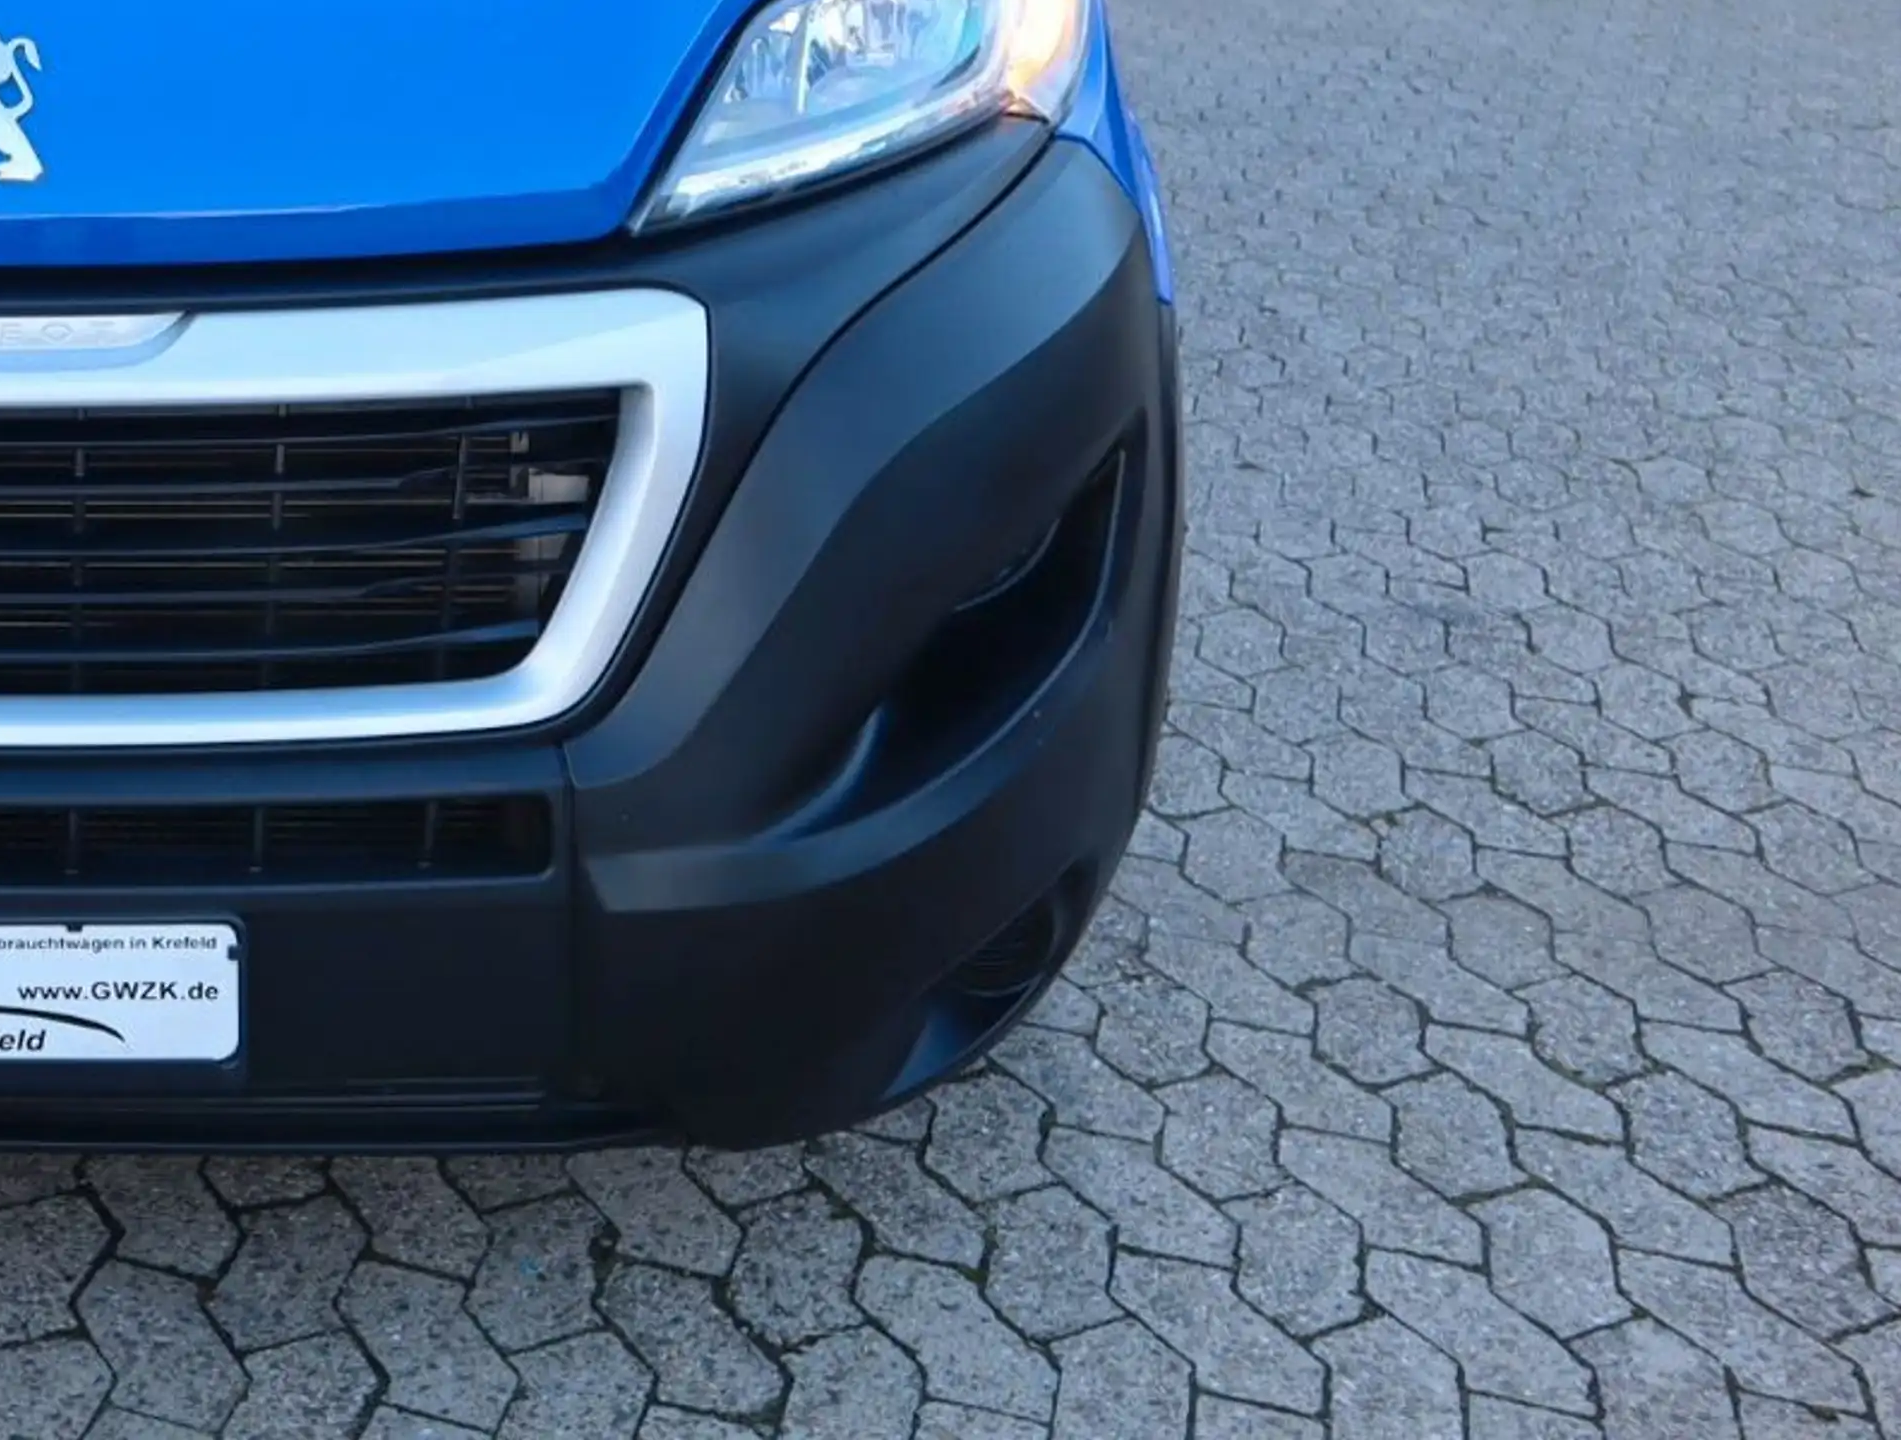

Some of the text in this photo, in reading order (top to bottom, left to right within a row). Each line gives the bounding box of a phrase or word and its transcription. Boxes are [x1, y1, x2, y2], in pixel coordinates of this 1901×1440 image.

[130, 936, 145, 950] in
[152, 936, 217, 950] Krefeld
[18, 981, 219, 1002] www.GWZK.de
